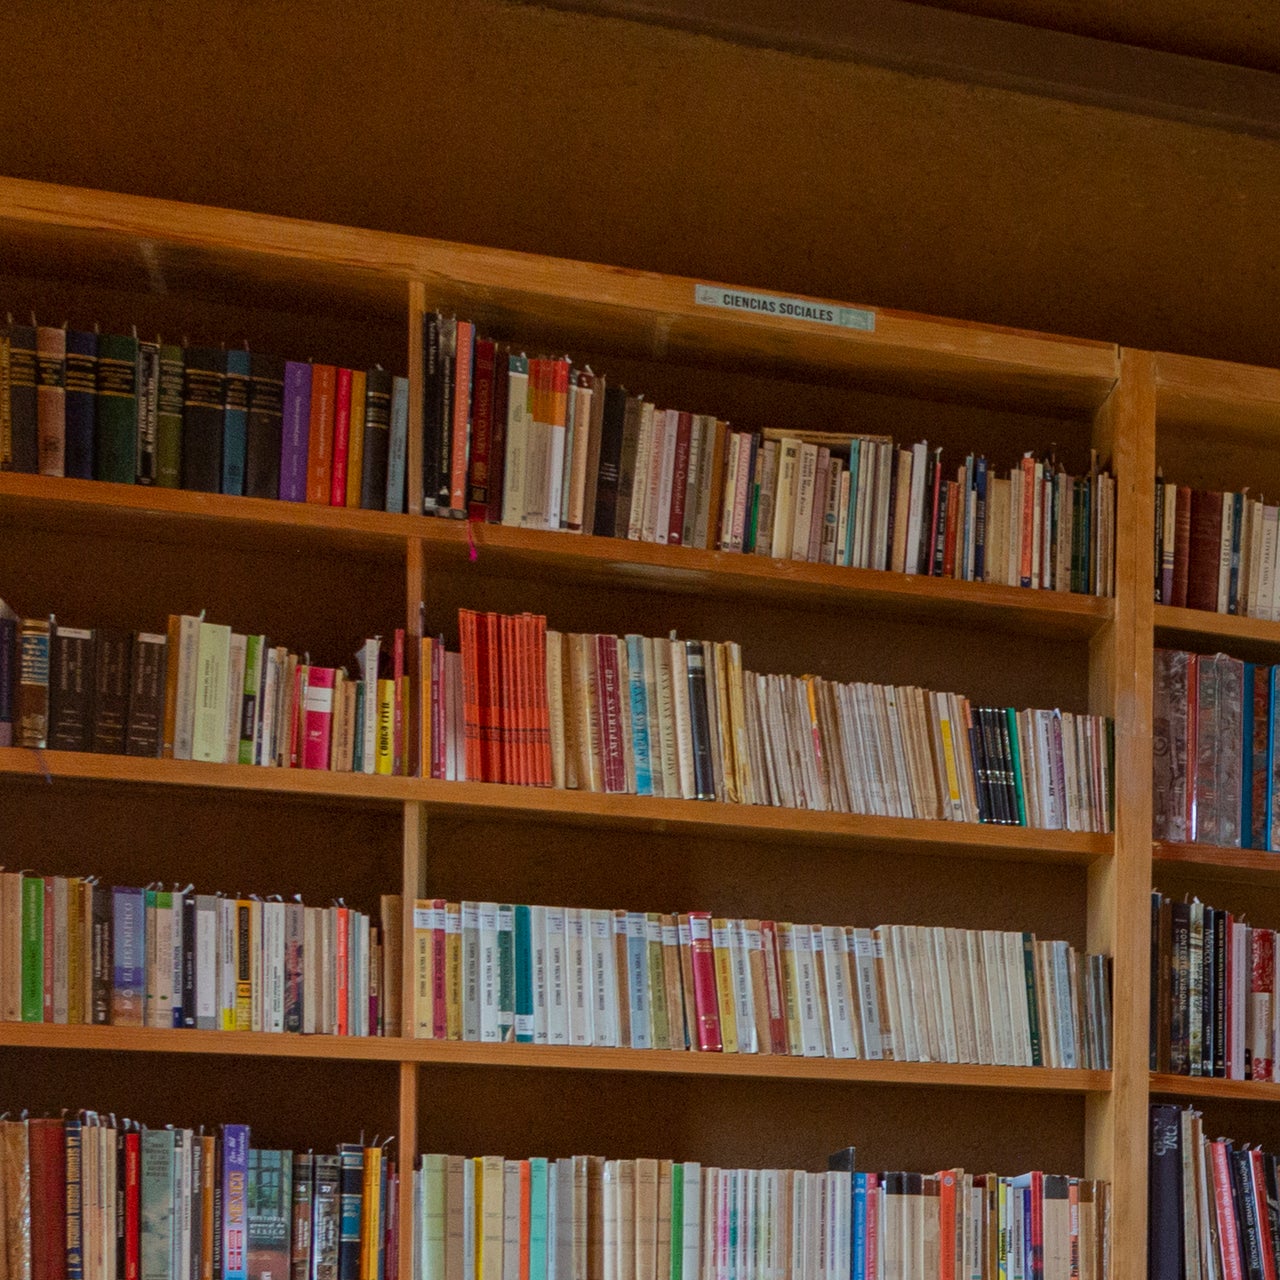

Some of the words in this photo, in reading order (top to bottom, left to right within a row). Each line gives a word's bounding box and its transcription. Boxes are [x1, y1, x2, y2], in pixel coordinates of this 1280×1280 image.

[723, 294, 776, 313] CIENCIAS
[779, 302, 833, 322] SOCIALES
[607, 698, 619, 758] AMPURIAS
[1179, 928, 1188, 975] CONTESTED
[1179, 978, 1187, 1011] VISIONS
[67, 1148, 80, 1183] SEGUNDA
[67, 1183, 80, 1214] GUERRA
[1245, 1196, 1255, 1225] GERMANY
[67, 1215, 80, 1249] MUNDIAL
[1248, 1227, 1260, 1269] DEUTSCHLAND
